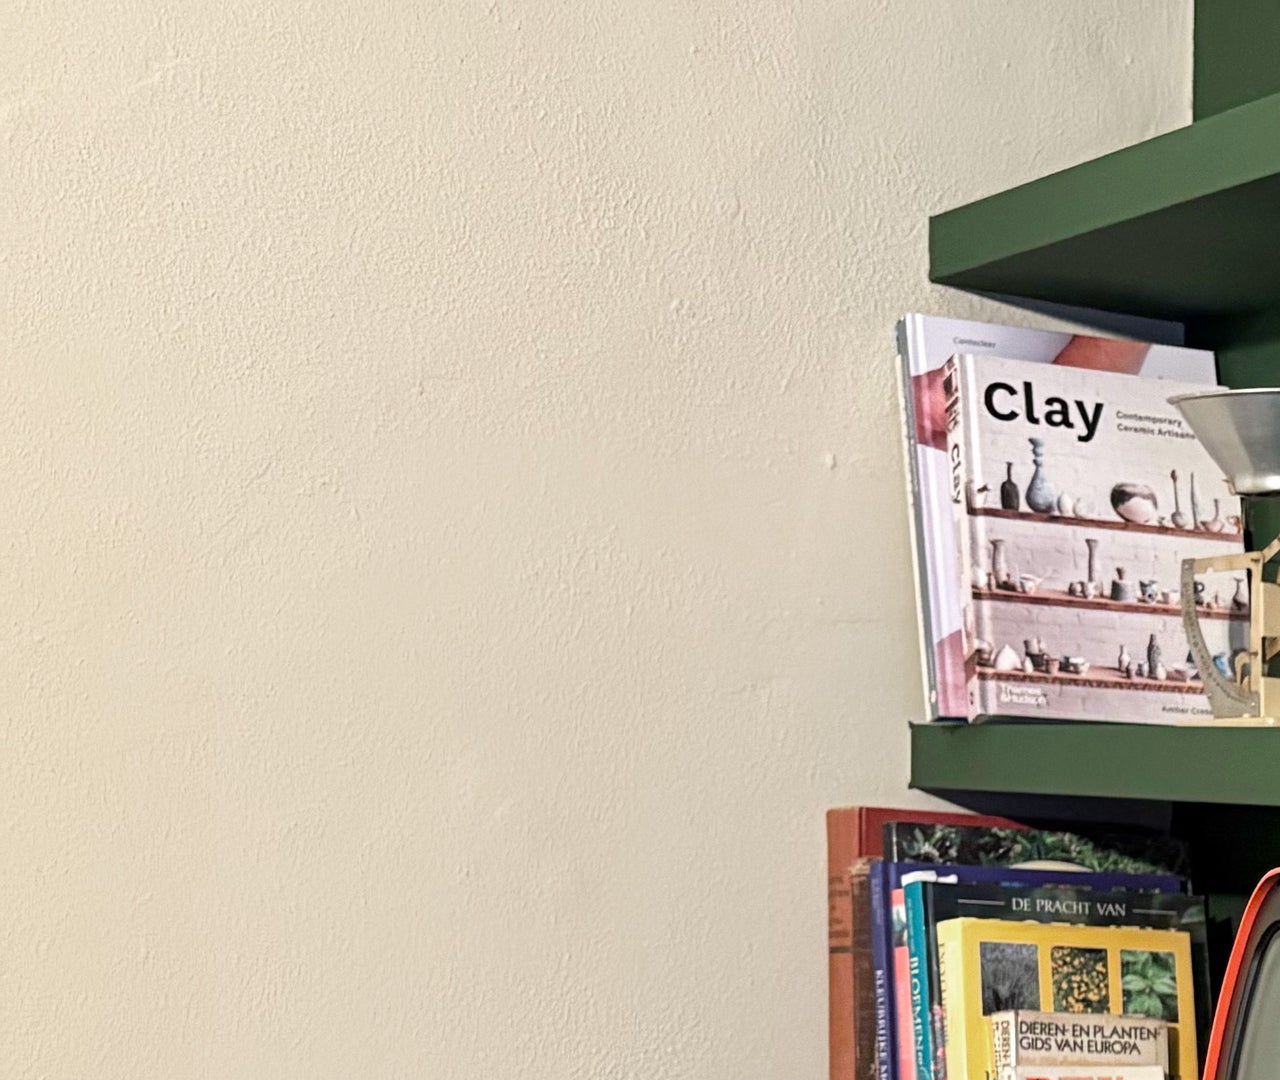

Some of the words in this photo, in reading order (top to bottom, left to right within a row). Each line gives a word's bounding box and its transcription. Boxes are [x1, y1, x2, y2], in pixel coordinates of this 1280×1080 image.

[984, 380, 1104, 443] Clay
[1115, 410, 1183, 429] Contemporary
[1116, 423, 1155, 436] Ceramic
[1011, 897, 1032, 912] DE
[1036, 898, 1092, 916] PRACHT
[1096, 902, 1127, 917] VAN
[875, 968, 888, 1056] KLEURRIJKE
[910, 957, 924, 1053] BLOEMEN
[1019, 1021, 1068, 1037] DIEREN-
[1072, 1023, 1090, 1038] EN
[1094, 1025, 1161, 1041] PLANTEN-
[1019, 1036, 1052, 1051] GIDS
[1055, 1038, 1086, 1052] VAN
[1087, 1040, 1142, 1055] EUROPA
